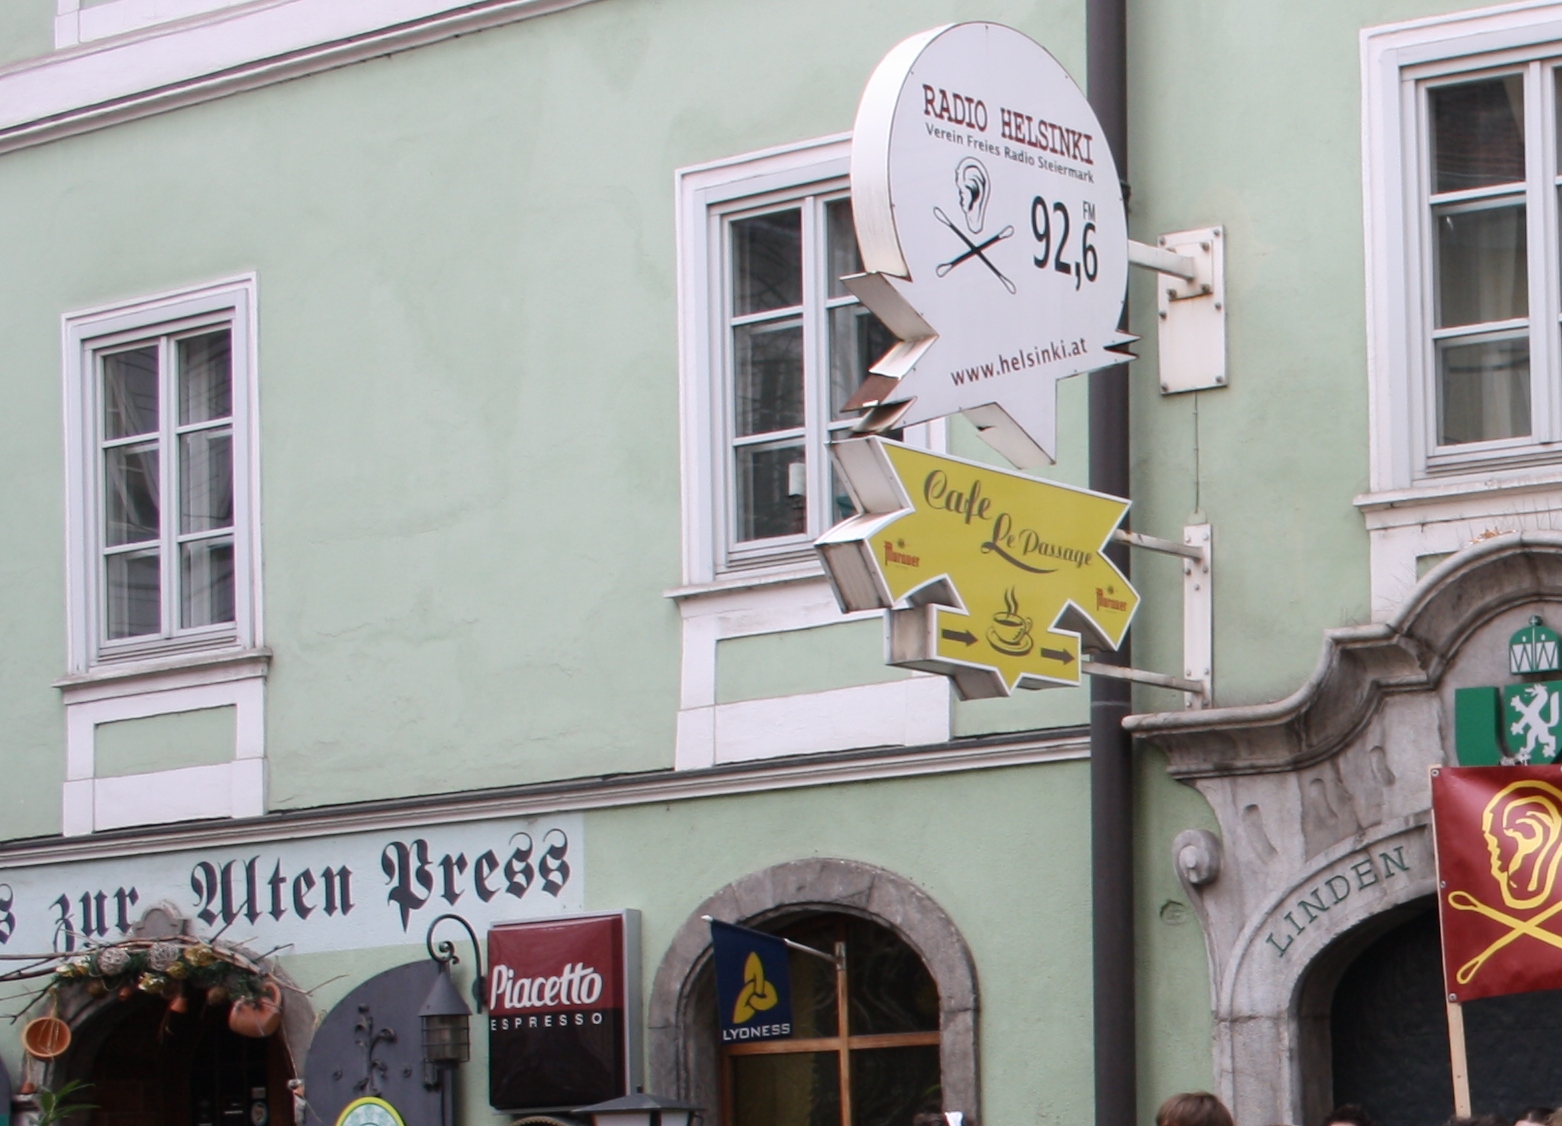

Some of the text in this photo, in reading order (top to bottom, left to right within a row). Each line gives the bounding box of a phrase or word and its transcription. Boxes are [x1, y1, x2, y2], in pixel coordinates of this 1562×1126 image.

[922, 84, 1094, 165] RADIO HELSINKI
[925, 122, 1095, 184] Verein Freies Radio Steiermark
[1083, 201, 1096, 221] FM
[1031, 195, 1098, 291] 92,6
[951, 338, 1088, 386] www.helsinki.at
[924, 469, 991, 525] Cafe
[1019, 529, 1094, 568] Passage
[49, 886, 140, 961] zur
[190, 854, 357, 928] Alten
[381, 828, 571, 934] Press
[1265, 846, 1411, 958] LINDEN
[490, 962, 603, 1010] Piacetto
[491, 1013, 603, 1031] ESPRESSO
[723, 1022, 791, 1041] LYONESS
